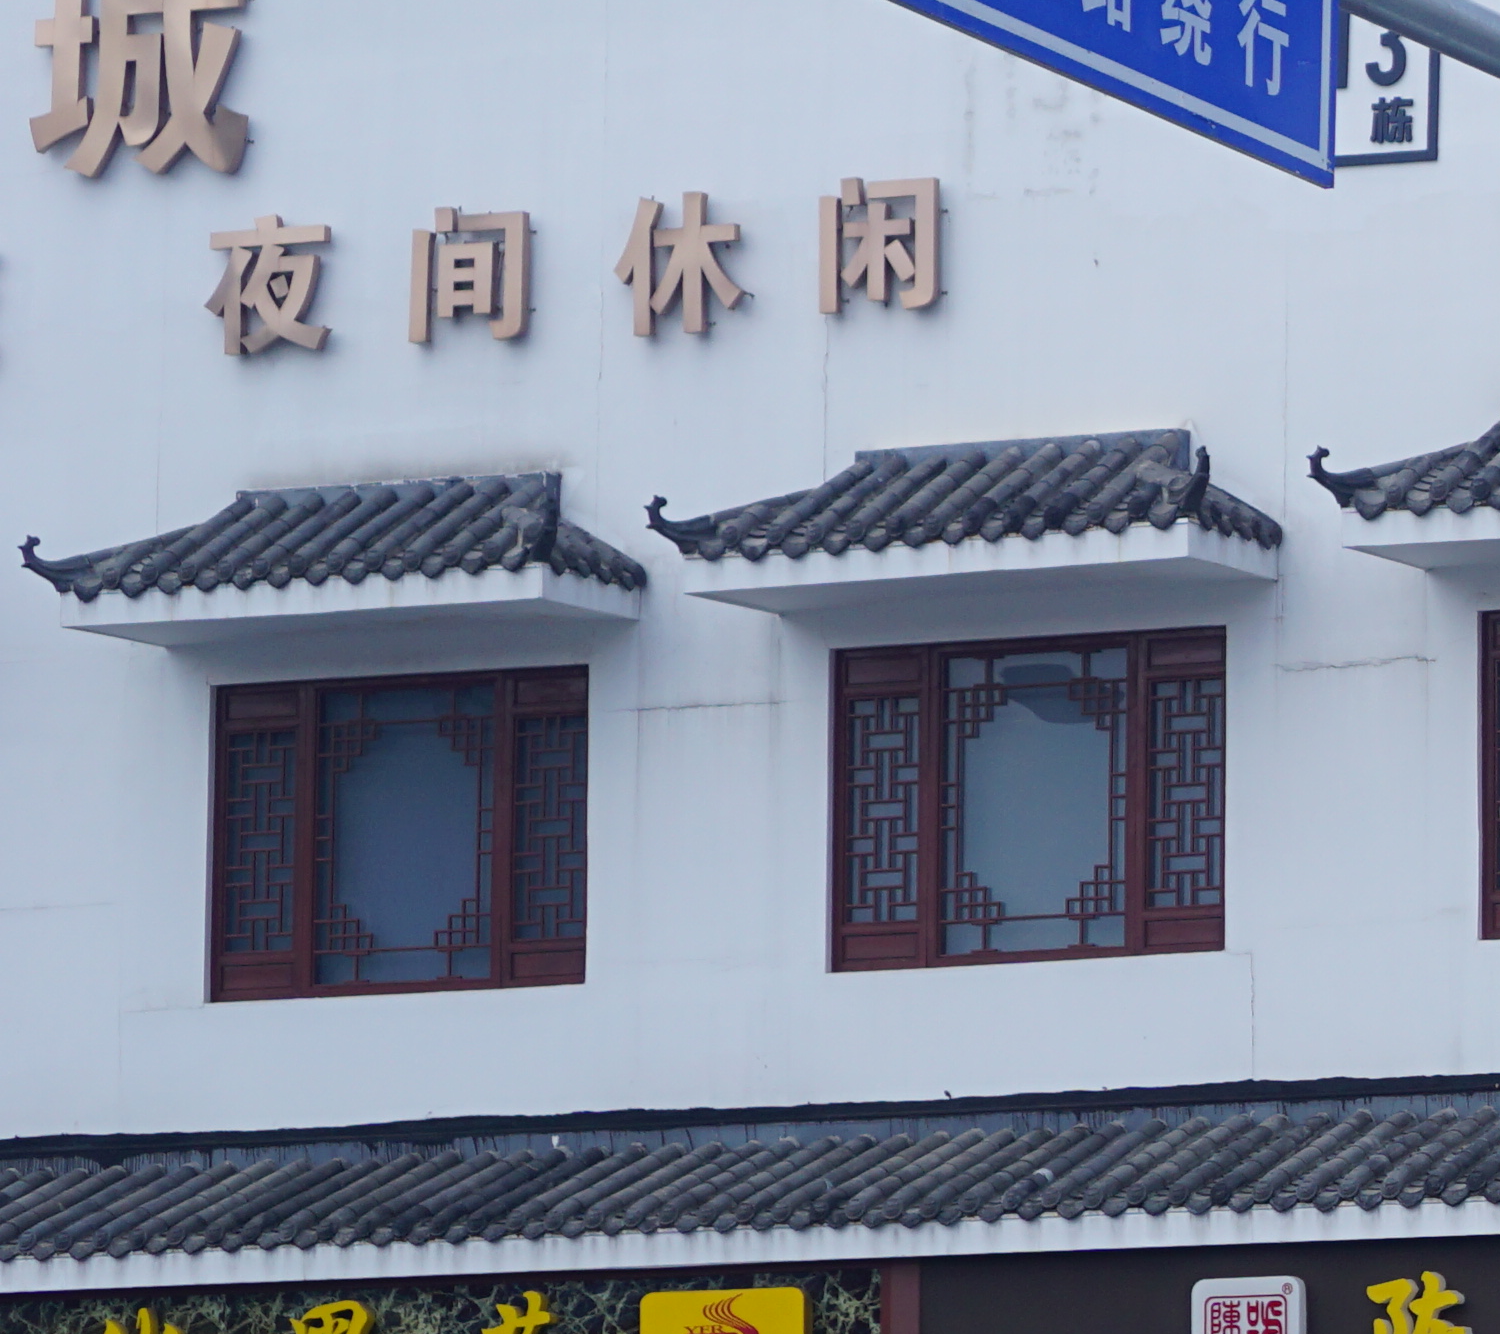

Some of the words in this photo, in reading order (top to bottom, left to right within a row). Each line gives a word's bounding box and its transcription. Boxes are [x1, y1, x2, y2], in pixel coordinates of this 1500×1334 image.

[1370, 97, 1414, 144] 栋
[205, 177, 943, 356] 夜间休闲
